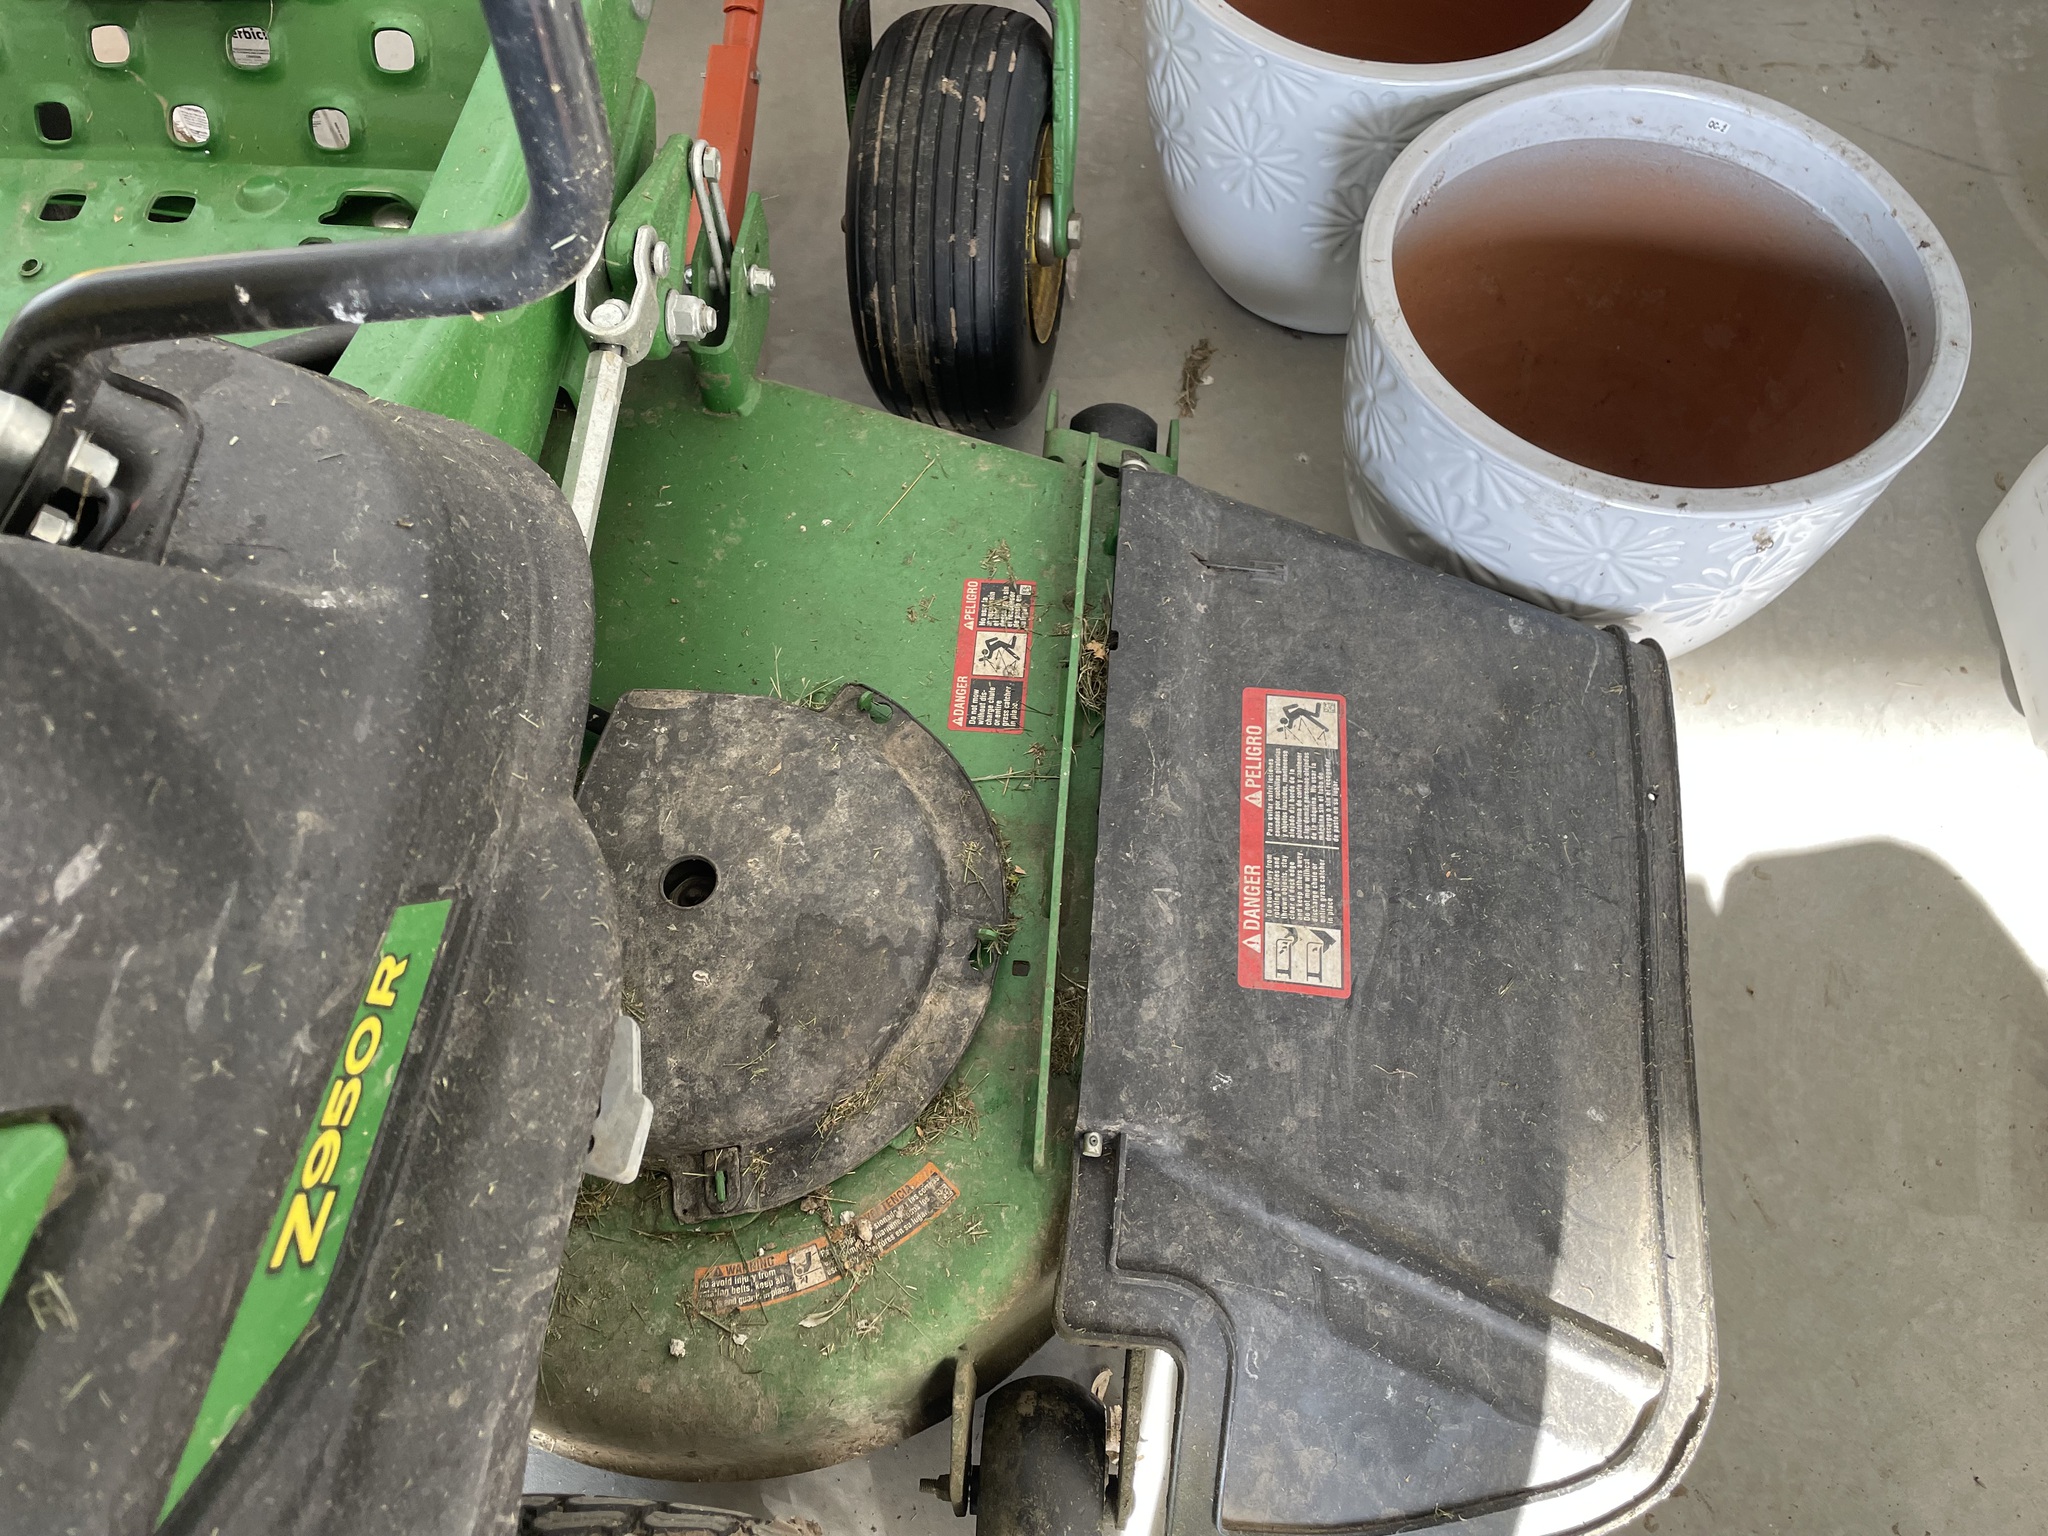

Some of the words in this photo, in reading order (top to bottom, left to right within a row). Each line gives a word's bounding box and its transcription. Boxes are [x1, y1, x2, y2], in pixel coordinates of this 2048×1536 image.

[965, 581, 978, 621] PELIGRO
[953, 676, 968, 715] DANGER
[987, 687, 995, 703] chute
[969, 716, 976, 724] Do
[986, 705, 994, 725] charge
[1245, 725, 1262, 788] PELIGRO
[1243, 865, 1260, 931] DANGER
[266, 954, 409, 1271] Z950R
[726, 1257, 774, 1275] WANING
